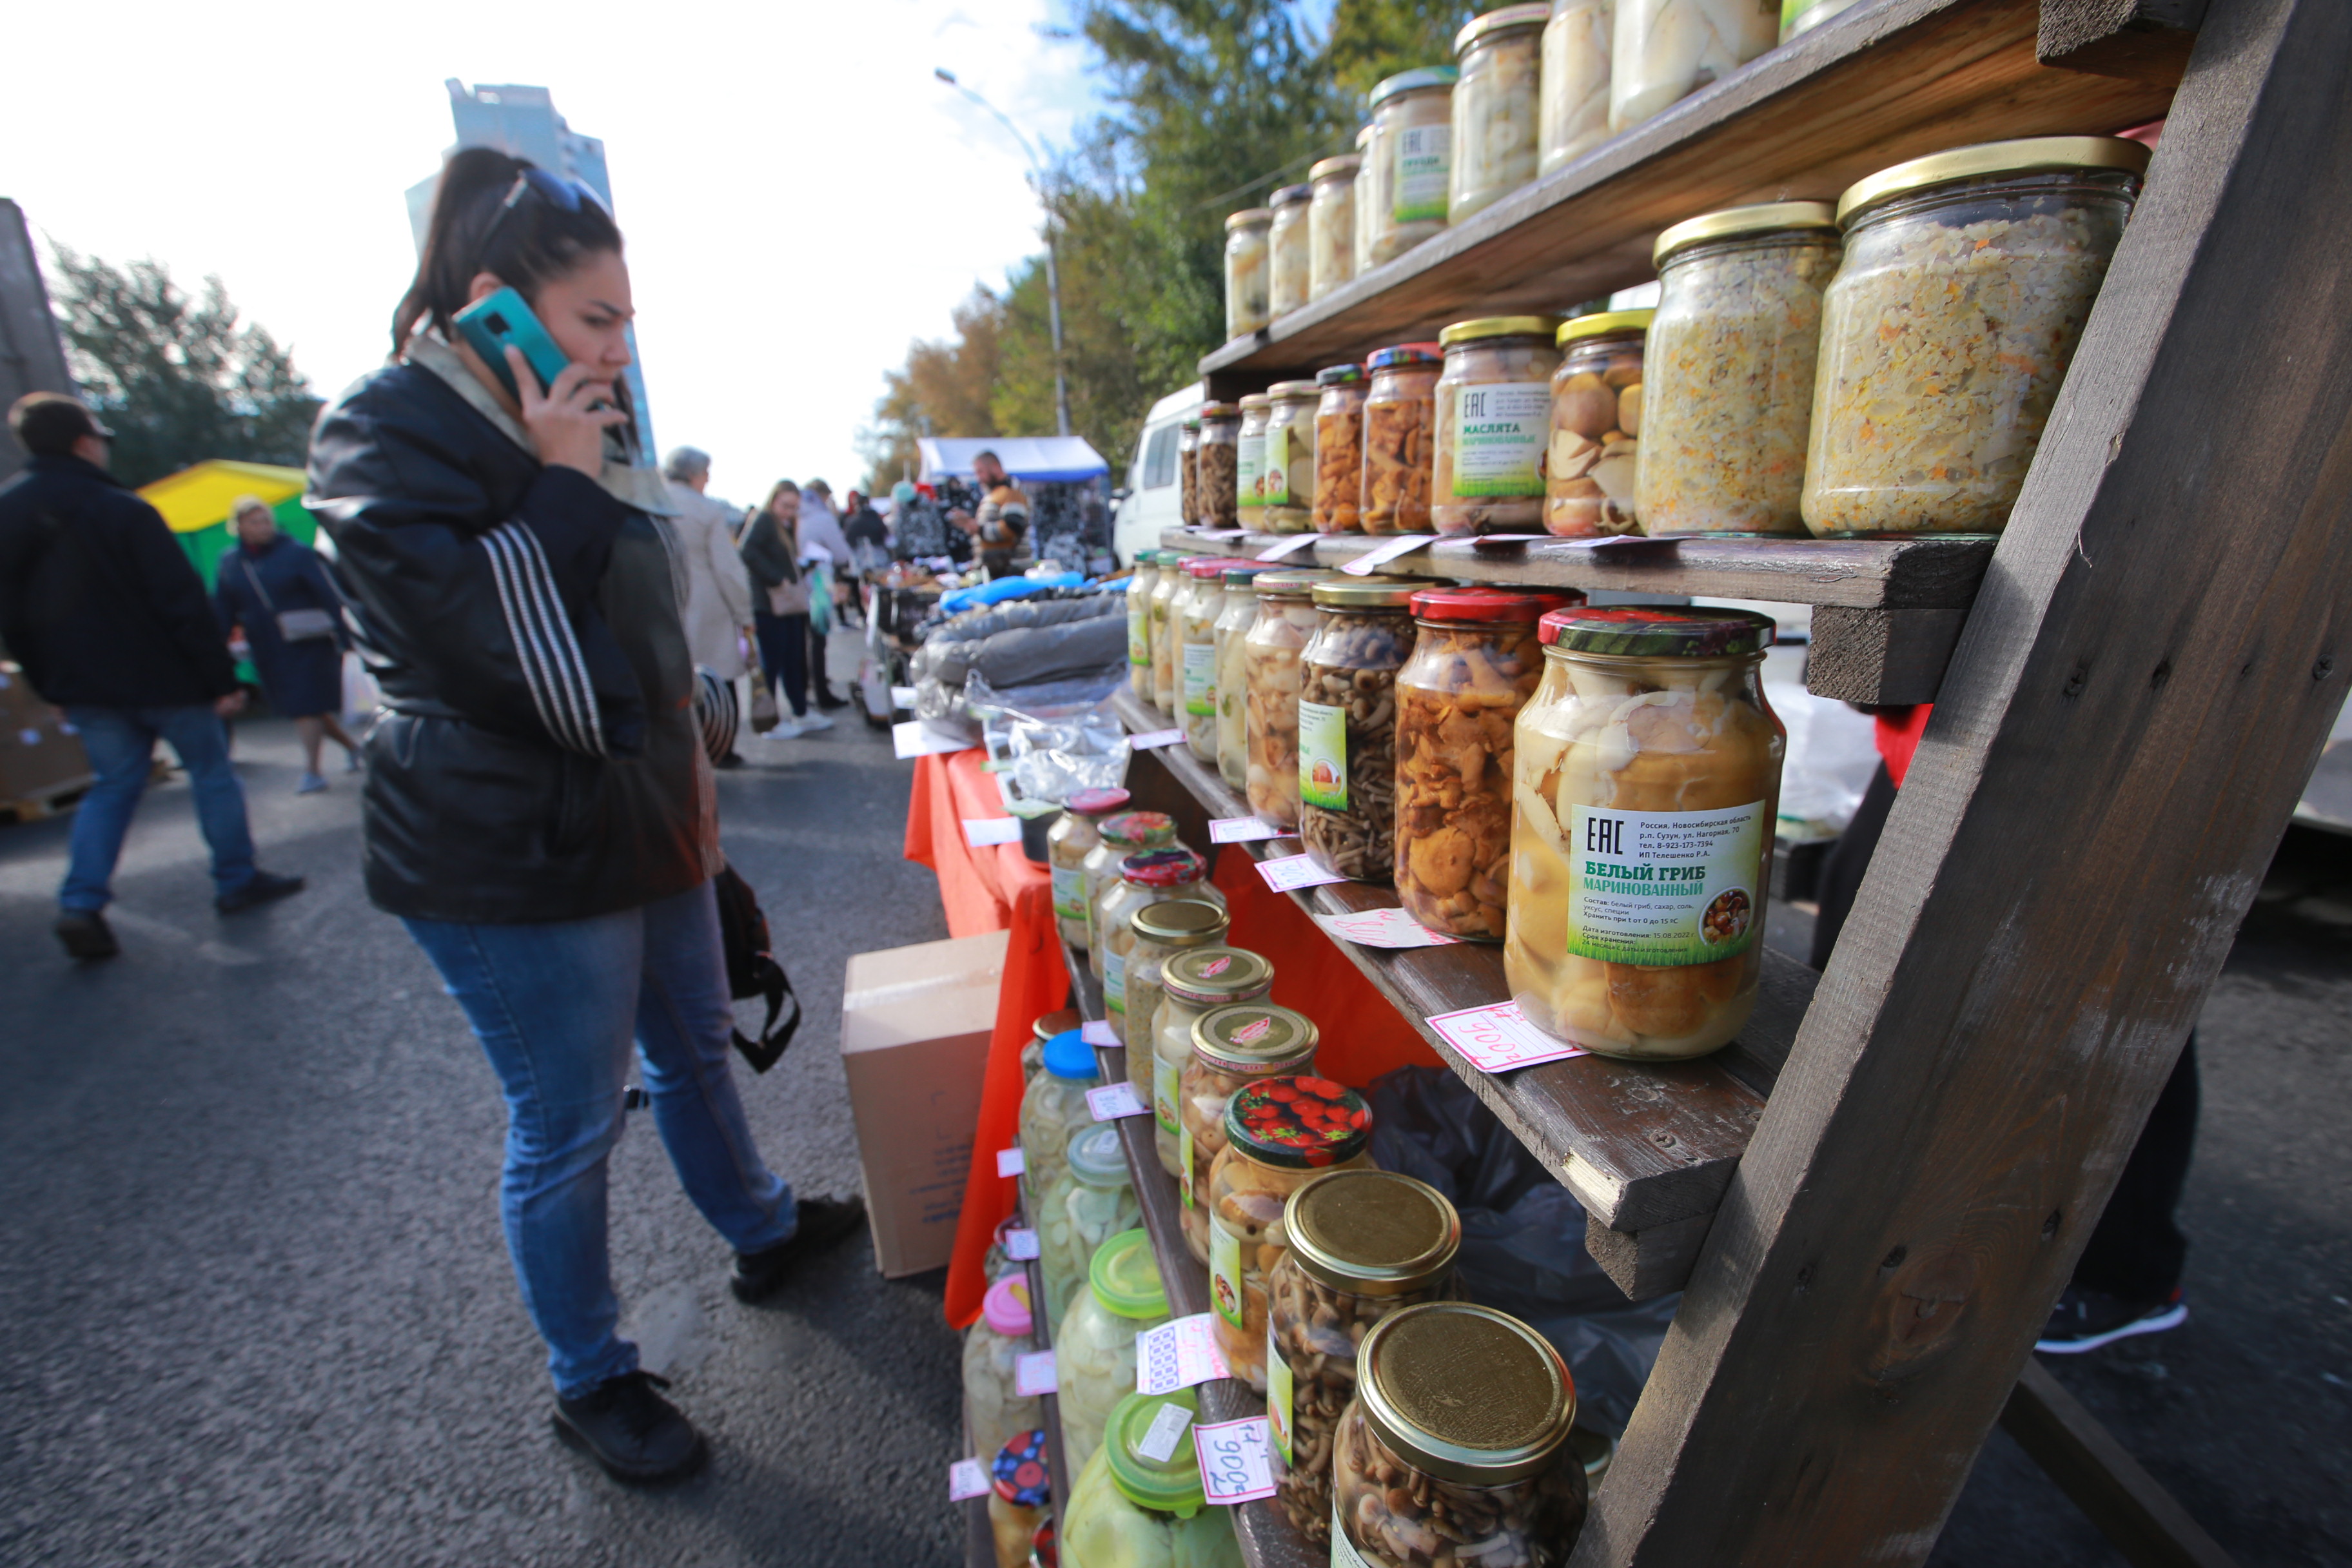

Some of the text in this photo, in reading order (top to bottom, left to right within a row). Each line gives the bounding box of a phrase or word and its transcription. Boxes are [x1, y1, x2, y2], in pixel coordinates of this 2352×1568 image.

[1464, 423, 1521, 434] МАСЛЯТА
[1672, 819, 1728, 828] Новосибирская
[1729, 816, 1751, 824] область
[1696, 829, 1730, 838] Нагорная,
[1657, 841, 1713, 849] 8-923-173-7394
[1585, 861, 1706, 881] БЕЛЫЙ ГРИБ
[1583, 877, 1703, 896] МАРИНОВАННЫЙ
[1584, 897, 1610, 906] Состав:
[1583, 905, 1603, 913] уксус,
[1583, 911, 1612, 921] Хранить
[1600, 929, 1651, 938] изготовления:
[1600, 937, 1636, 945] хранения:
